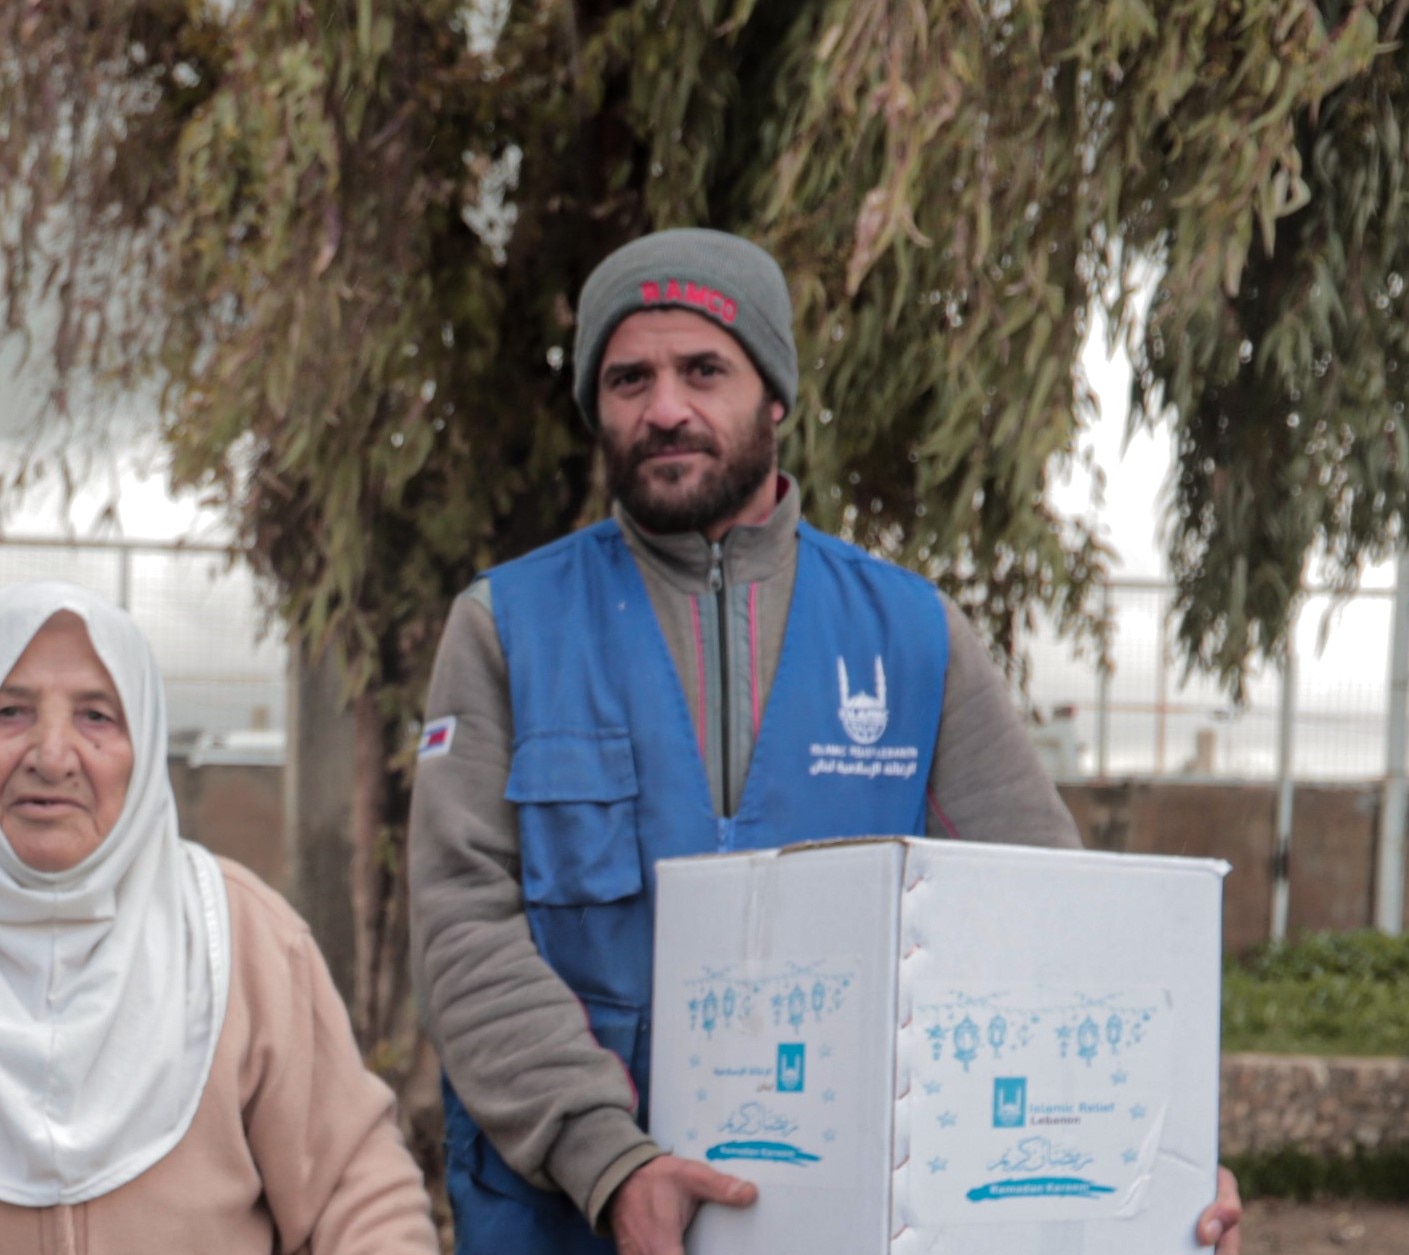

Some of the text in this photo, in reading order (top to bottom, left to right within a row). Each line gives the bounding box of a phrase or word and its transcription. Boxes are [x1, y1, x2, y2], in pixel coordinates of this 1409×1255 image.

[1030, 1101, 1116, 1114] Islamic Relief
[1030, 1115, 1082, 1126] Lebanon
